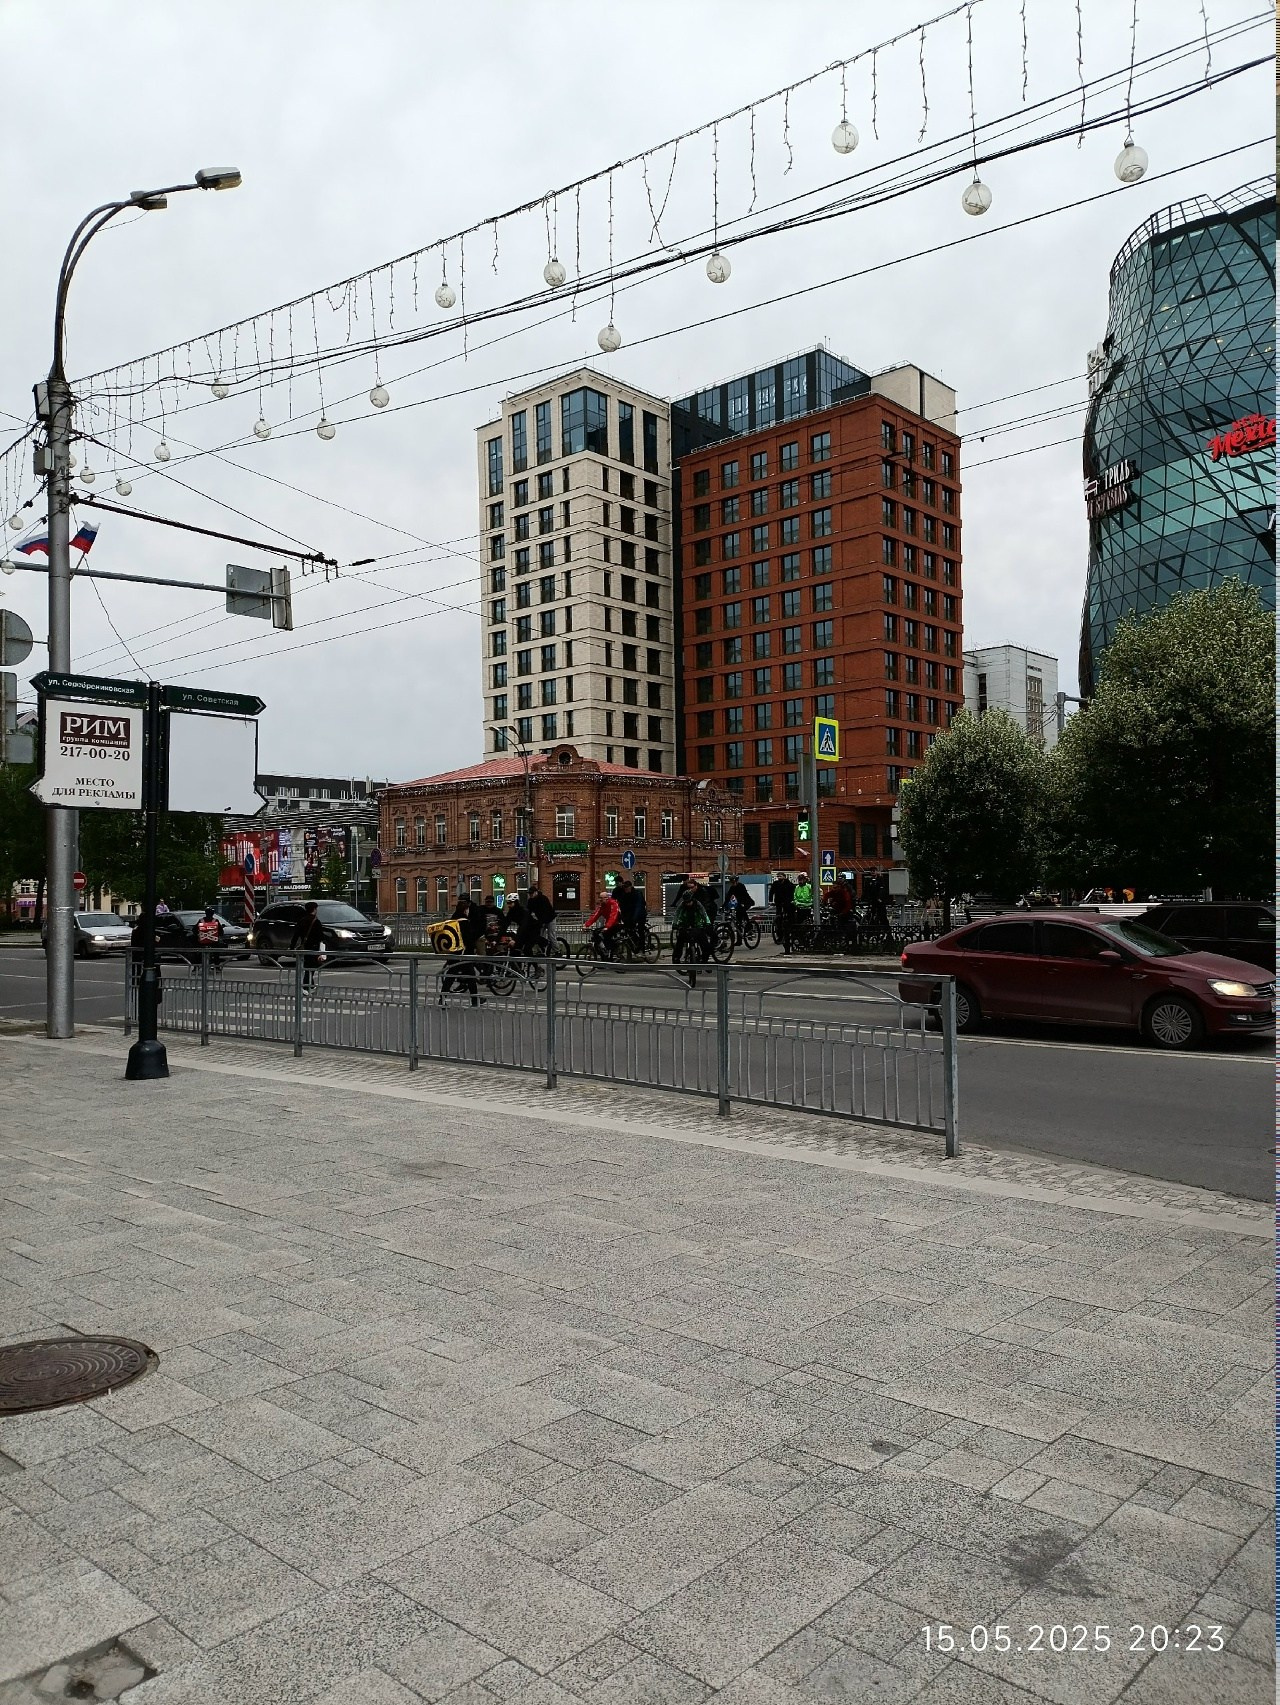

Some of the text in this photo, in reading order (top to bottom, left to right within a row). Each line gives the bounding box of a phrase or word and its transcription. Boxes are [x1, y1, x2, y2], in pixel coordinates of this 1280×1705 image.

[48, 678, 60, 687] ул.
[182, 693, 239, 706] ул. Советская
[63, 716, 127, 738] РИМ
[91, 738, 128, 746] компаний
[60, 746, 130, 761] 217-00-20
[75, 777, 115, 787] МЕСТО
[52, 787, 136, 799] ДЛЯ РЕКЛАМЫ
